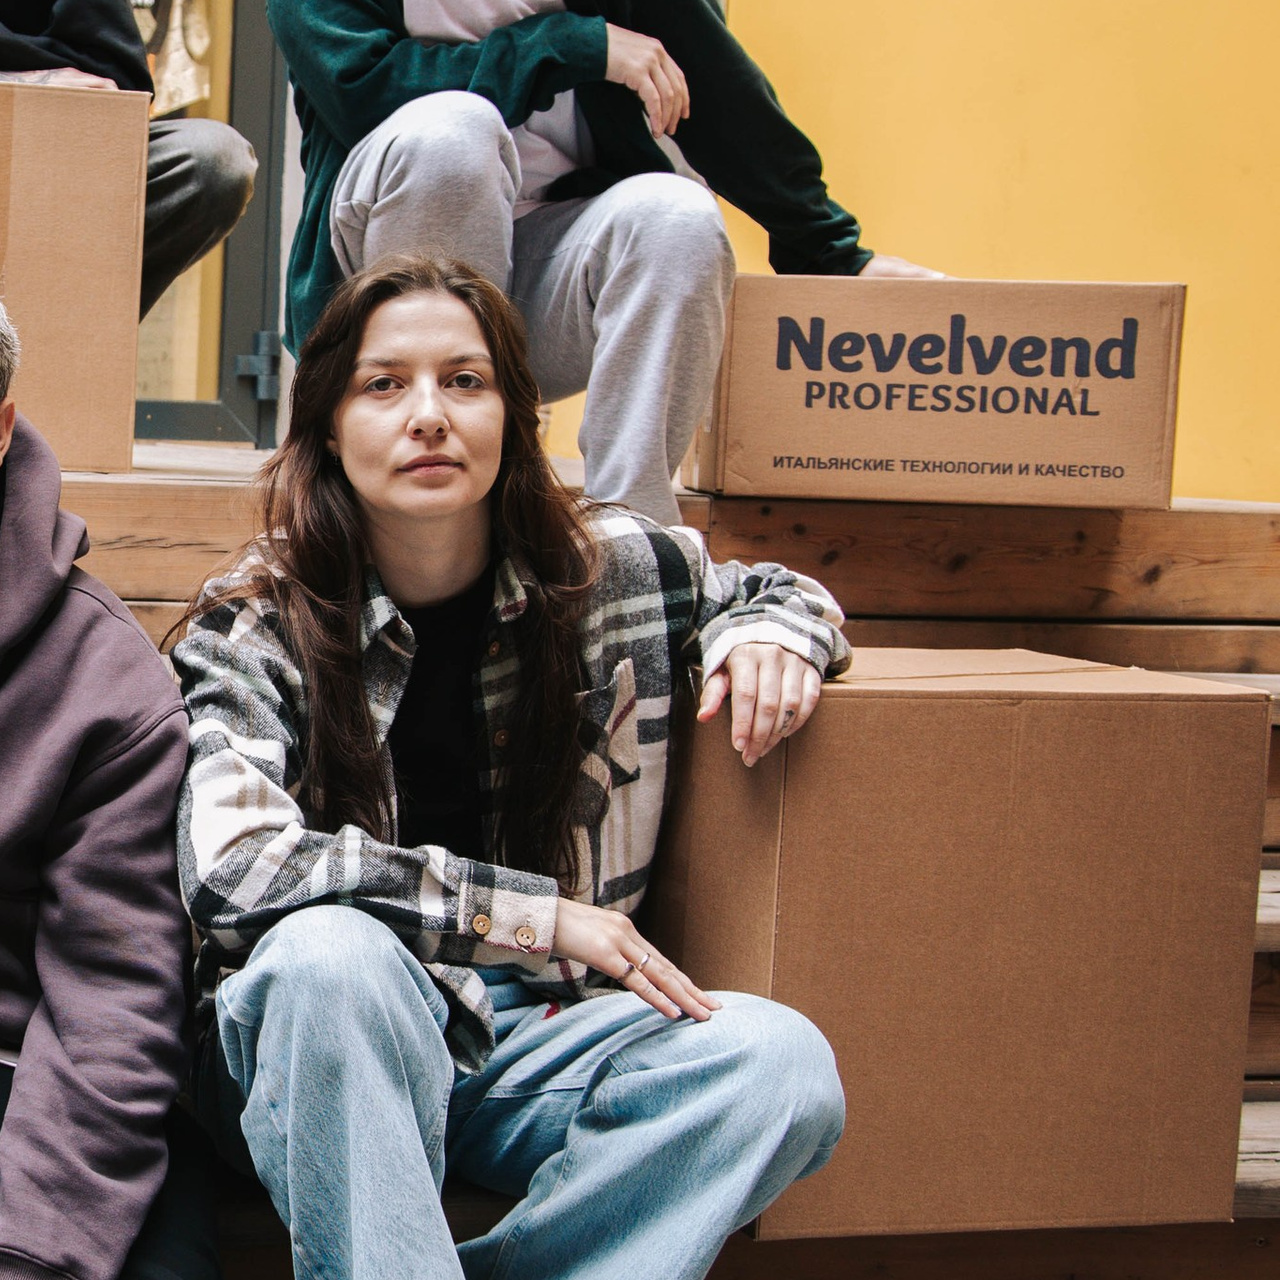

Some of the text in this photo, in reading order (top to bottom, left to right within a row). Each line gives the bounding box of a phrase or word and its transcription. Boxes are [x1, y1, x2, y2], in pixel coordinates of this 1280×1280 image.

[776, 313, 1139, 380] Nevelvend
[804, 381, 1100, 417] PROFESSIONAL
[773, 455, 1125, 480] ИТАЛЬЯНСКИЕ ТЕХНОЛОГИИ И КАЧЕСТВО
